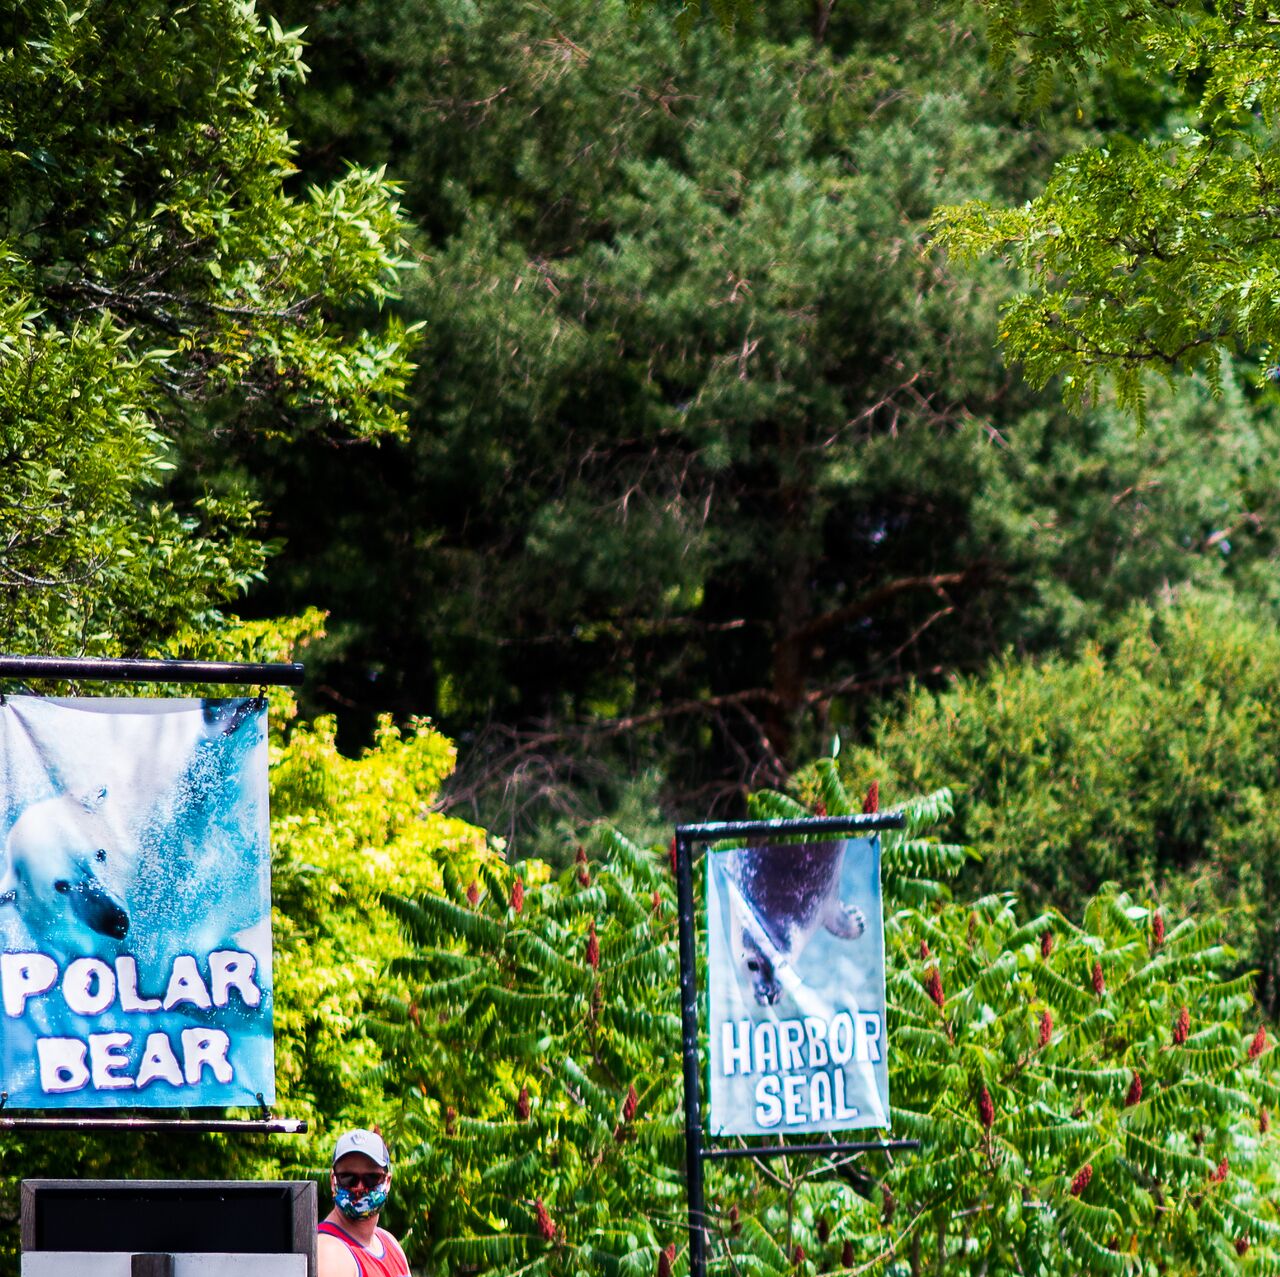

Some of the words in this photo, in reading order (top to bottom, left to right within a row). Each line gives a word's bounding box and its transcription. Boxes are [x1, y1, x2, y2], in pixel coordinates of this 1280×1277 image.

[0, 950, 261, 1018] POLAR
[37, 1028, 233, 1093] BEAR
[722, 1012, 881, 1076] HARBOR
[755, 1067, 858, 1127] SEAL
